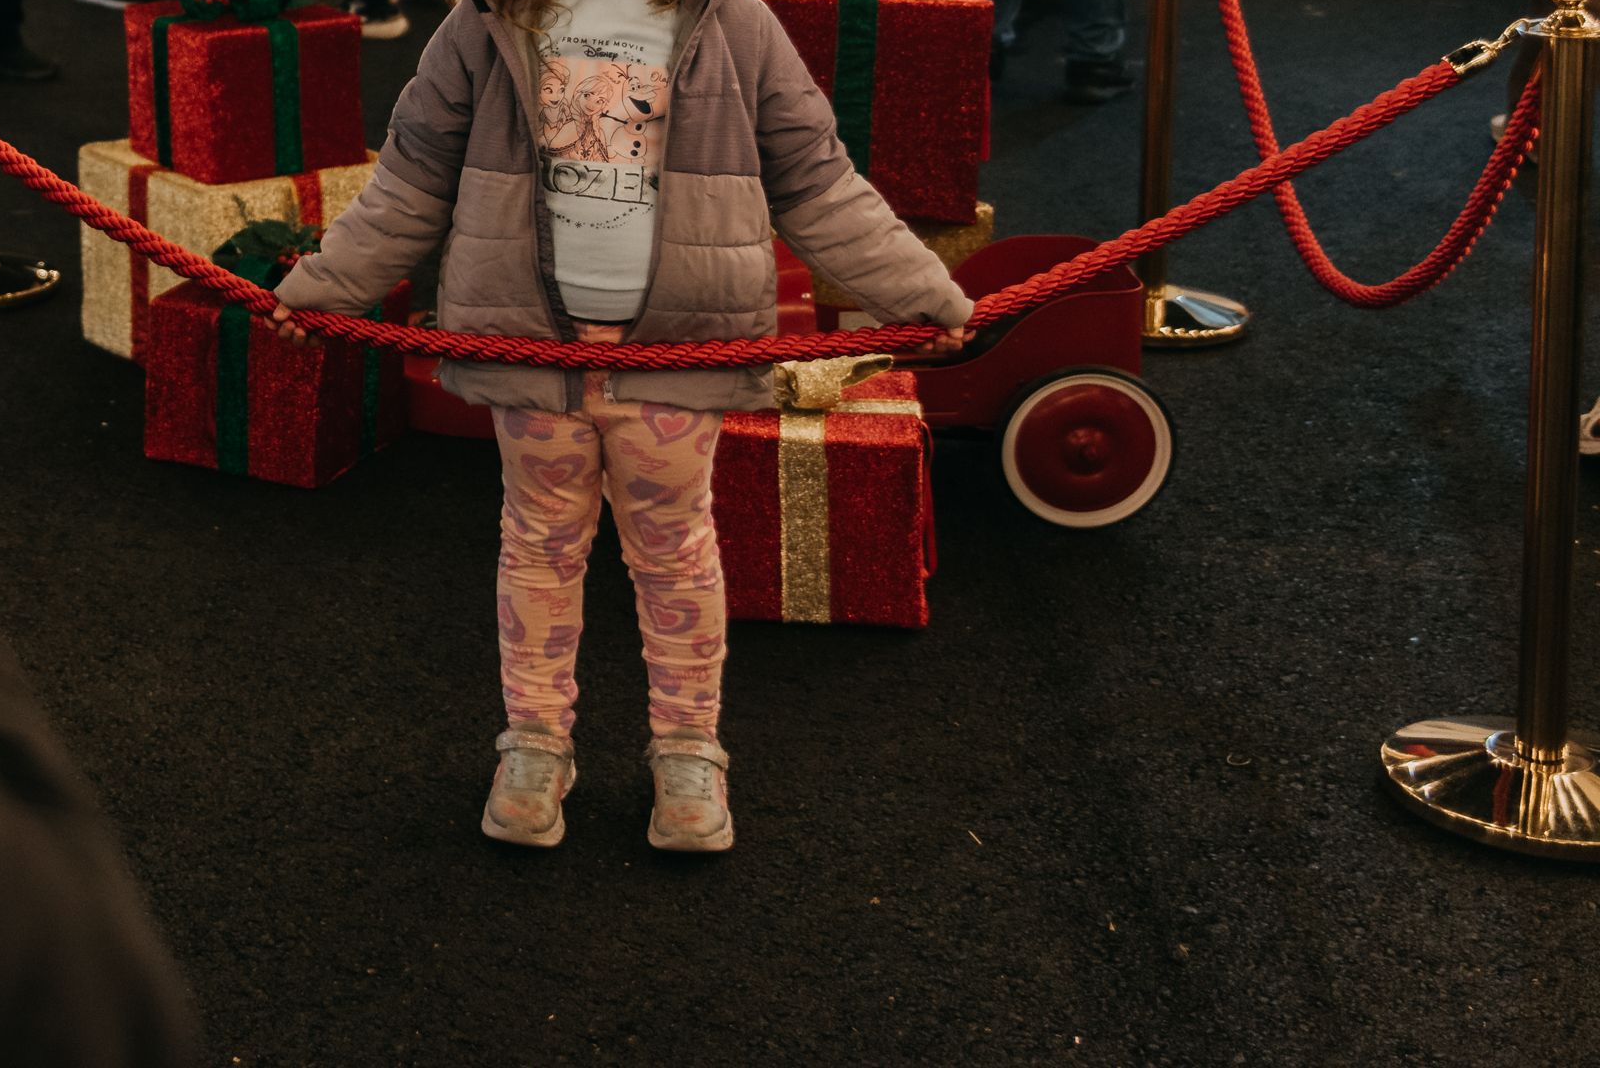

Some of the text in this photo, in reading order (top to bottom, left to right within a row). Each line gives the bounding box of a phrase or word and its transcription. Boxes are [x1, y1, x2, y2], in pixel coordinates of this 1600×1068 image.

[562, 36, 645, 52] FROM THE MOVIE
[582, 44, 619, 62] Disney
